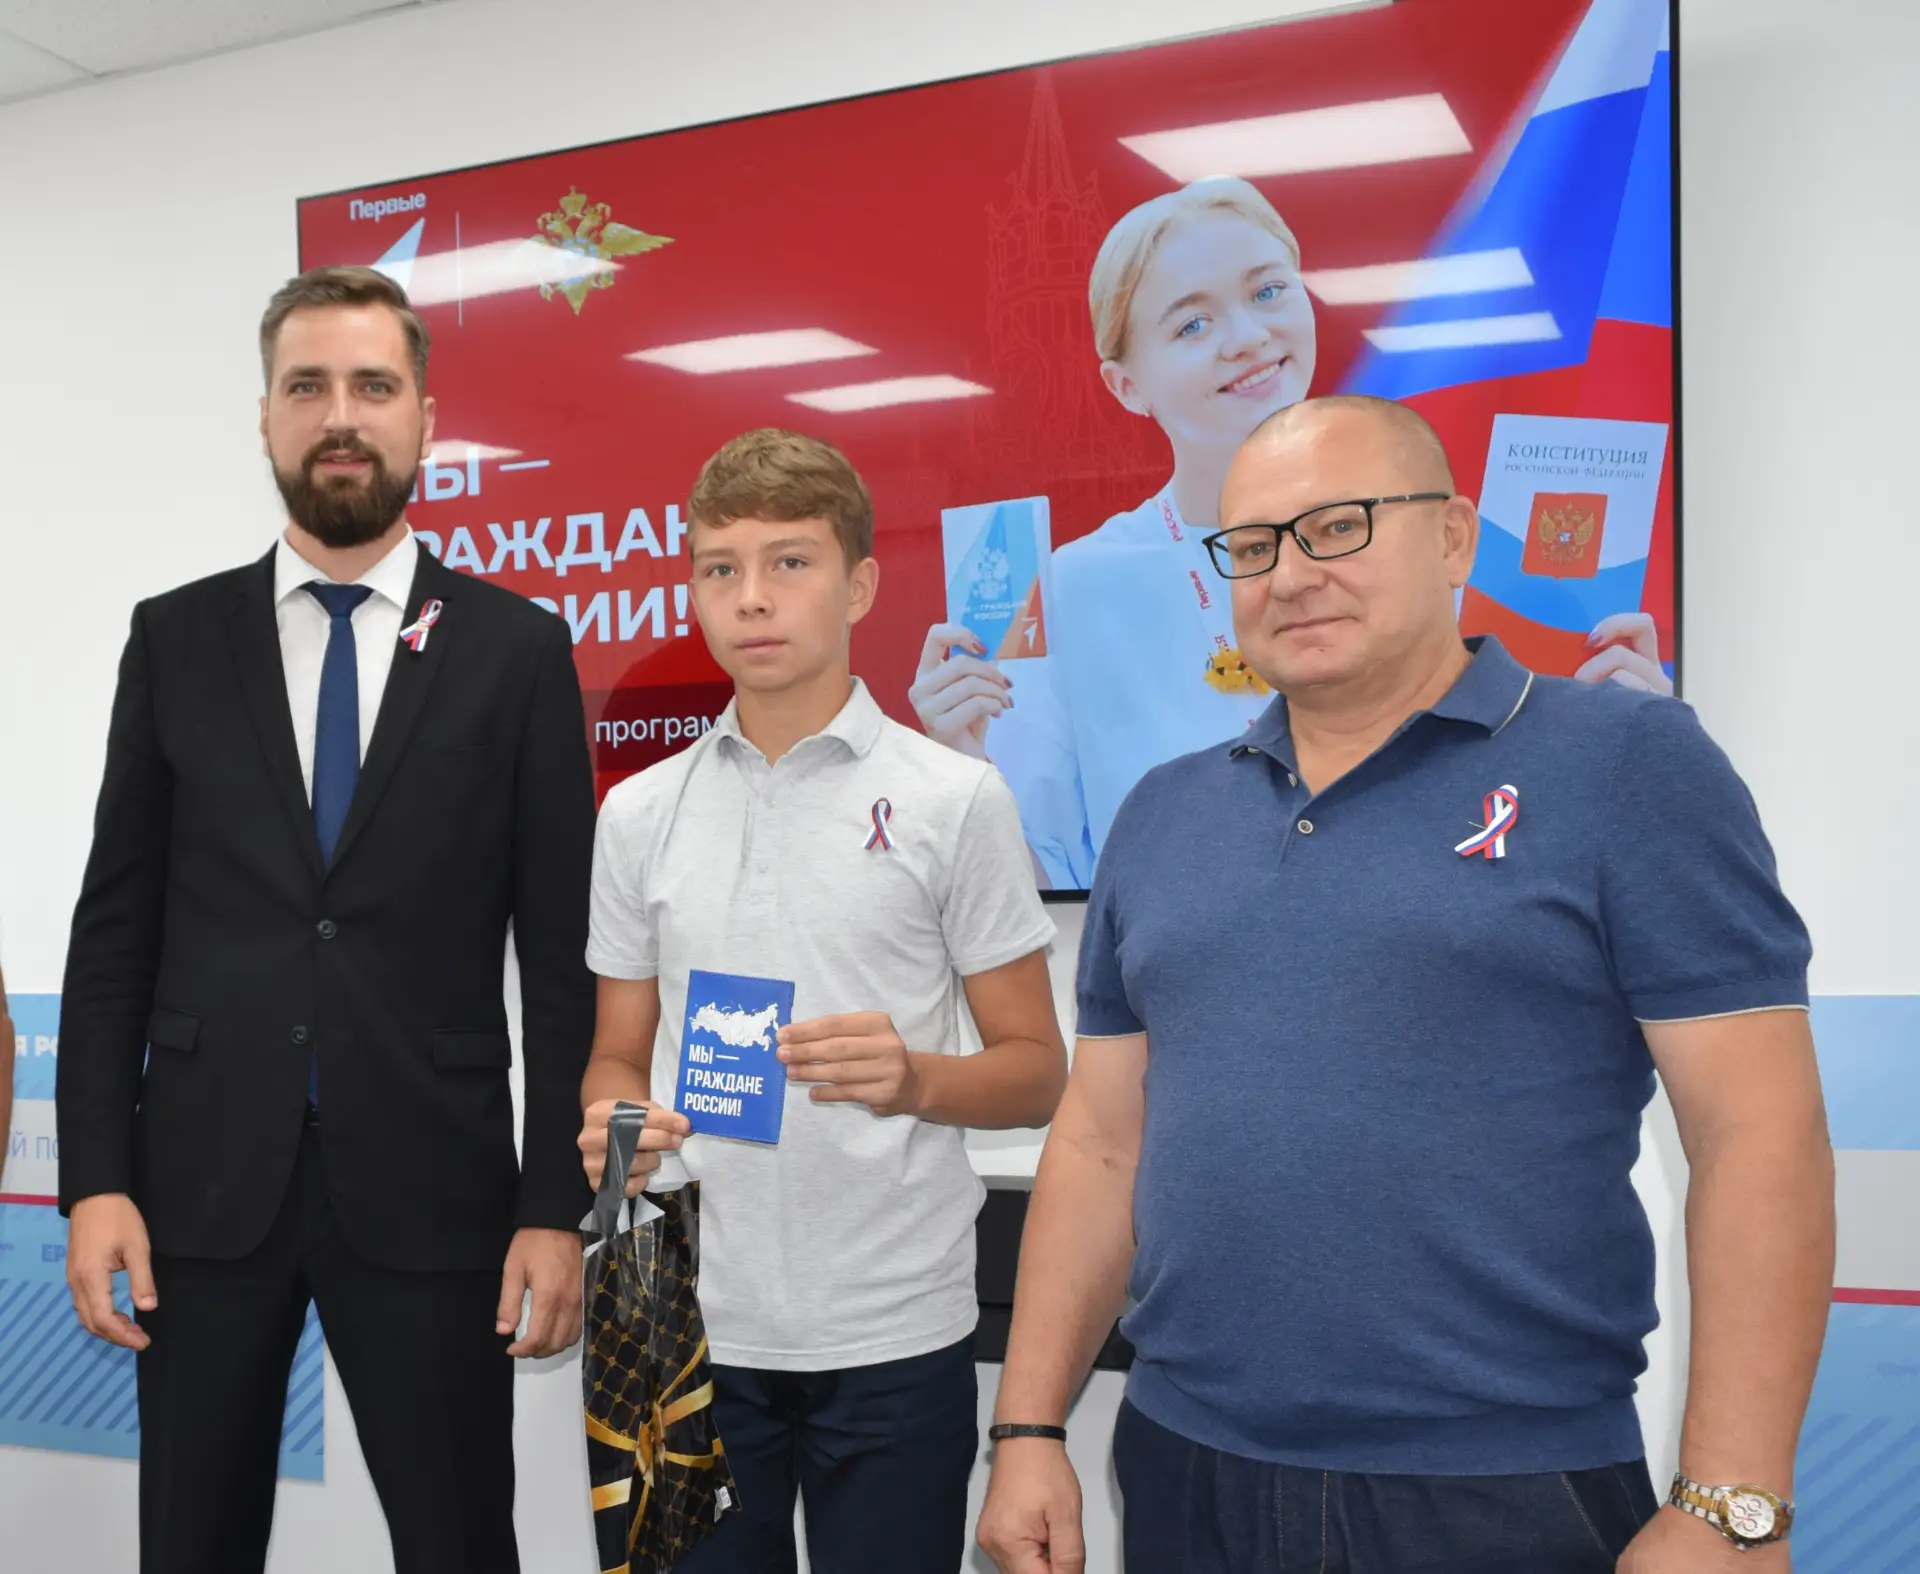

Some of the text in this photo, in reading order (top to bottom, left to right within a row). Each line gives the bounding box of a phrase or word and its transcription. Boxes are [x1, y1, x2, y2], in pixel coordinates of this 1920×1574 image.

[350, 192, 426, 222] Первые
[1507, 443, 1648, 468] КОНСТИТУЦИЯ
[409, 446, 480, 503] Ы
[688, 1044, 714, 1065] МЫ
[686, 1068, 764, 1095] ГРАЖДАНЕ
[684, 1092, 742, 1117] РОССИИ!
